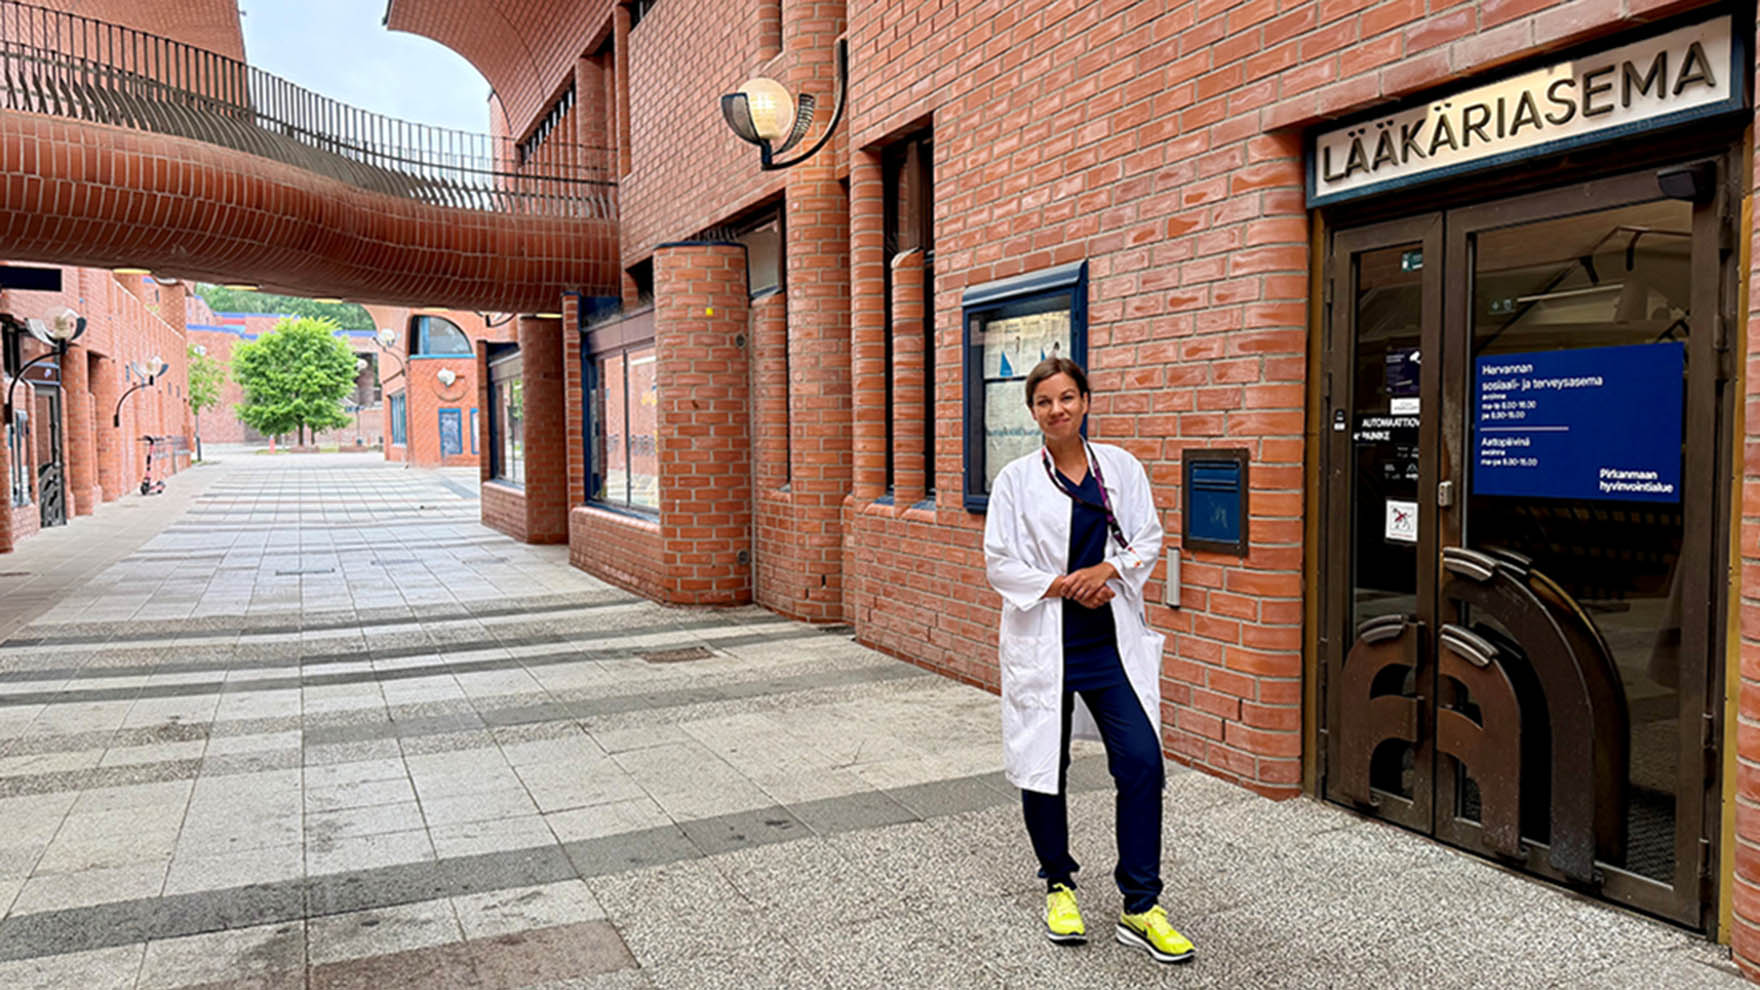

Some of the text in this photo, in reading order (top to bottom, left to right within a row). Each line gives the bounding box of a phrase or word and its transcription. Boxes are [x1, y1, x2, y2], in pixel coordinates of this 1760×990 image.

[1322, 41, 1717, 183] LÄÄKÄRIASEMA
[1482, 364, 1533, 375] Hervannan
[1482, 376, 1603, 391] sosiaali- ja terveysasema
[1481, 437, 1531, 448] Aattopäivinä
[1600, 468, 1658, 480] Pirkanmaan
[1600, 480, 1674, 493] hyvinvointialue
